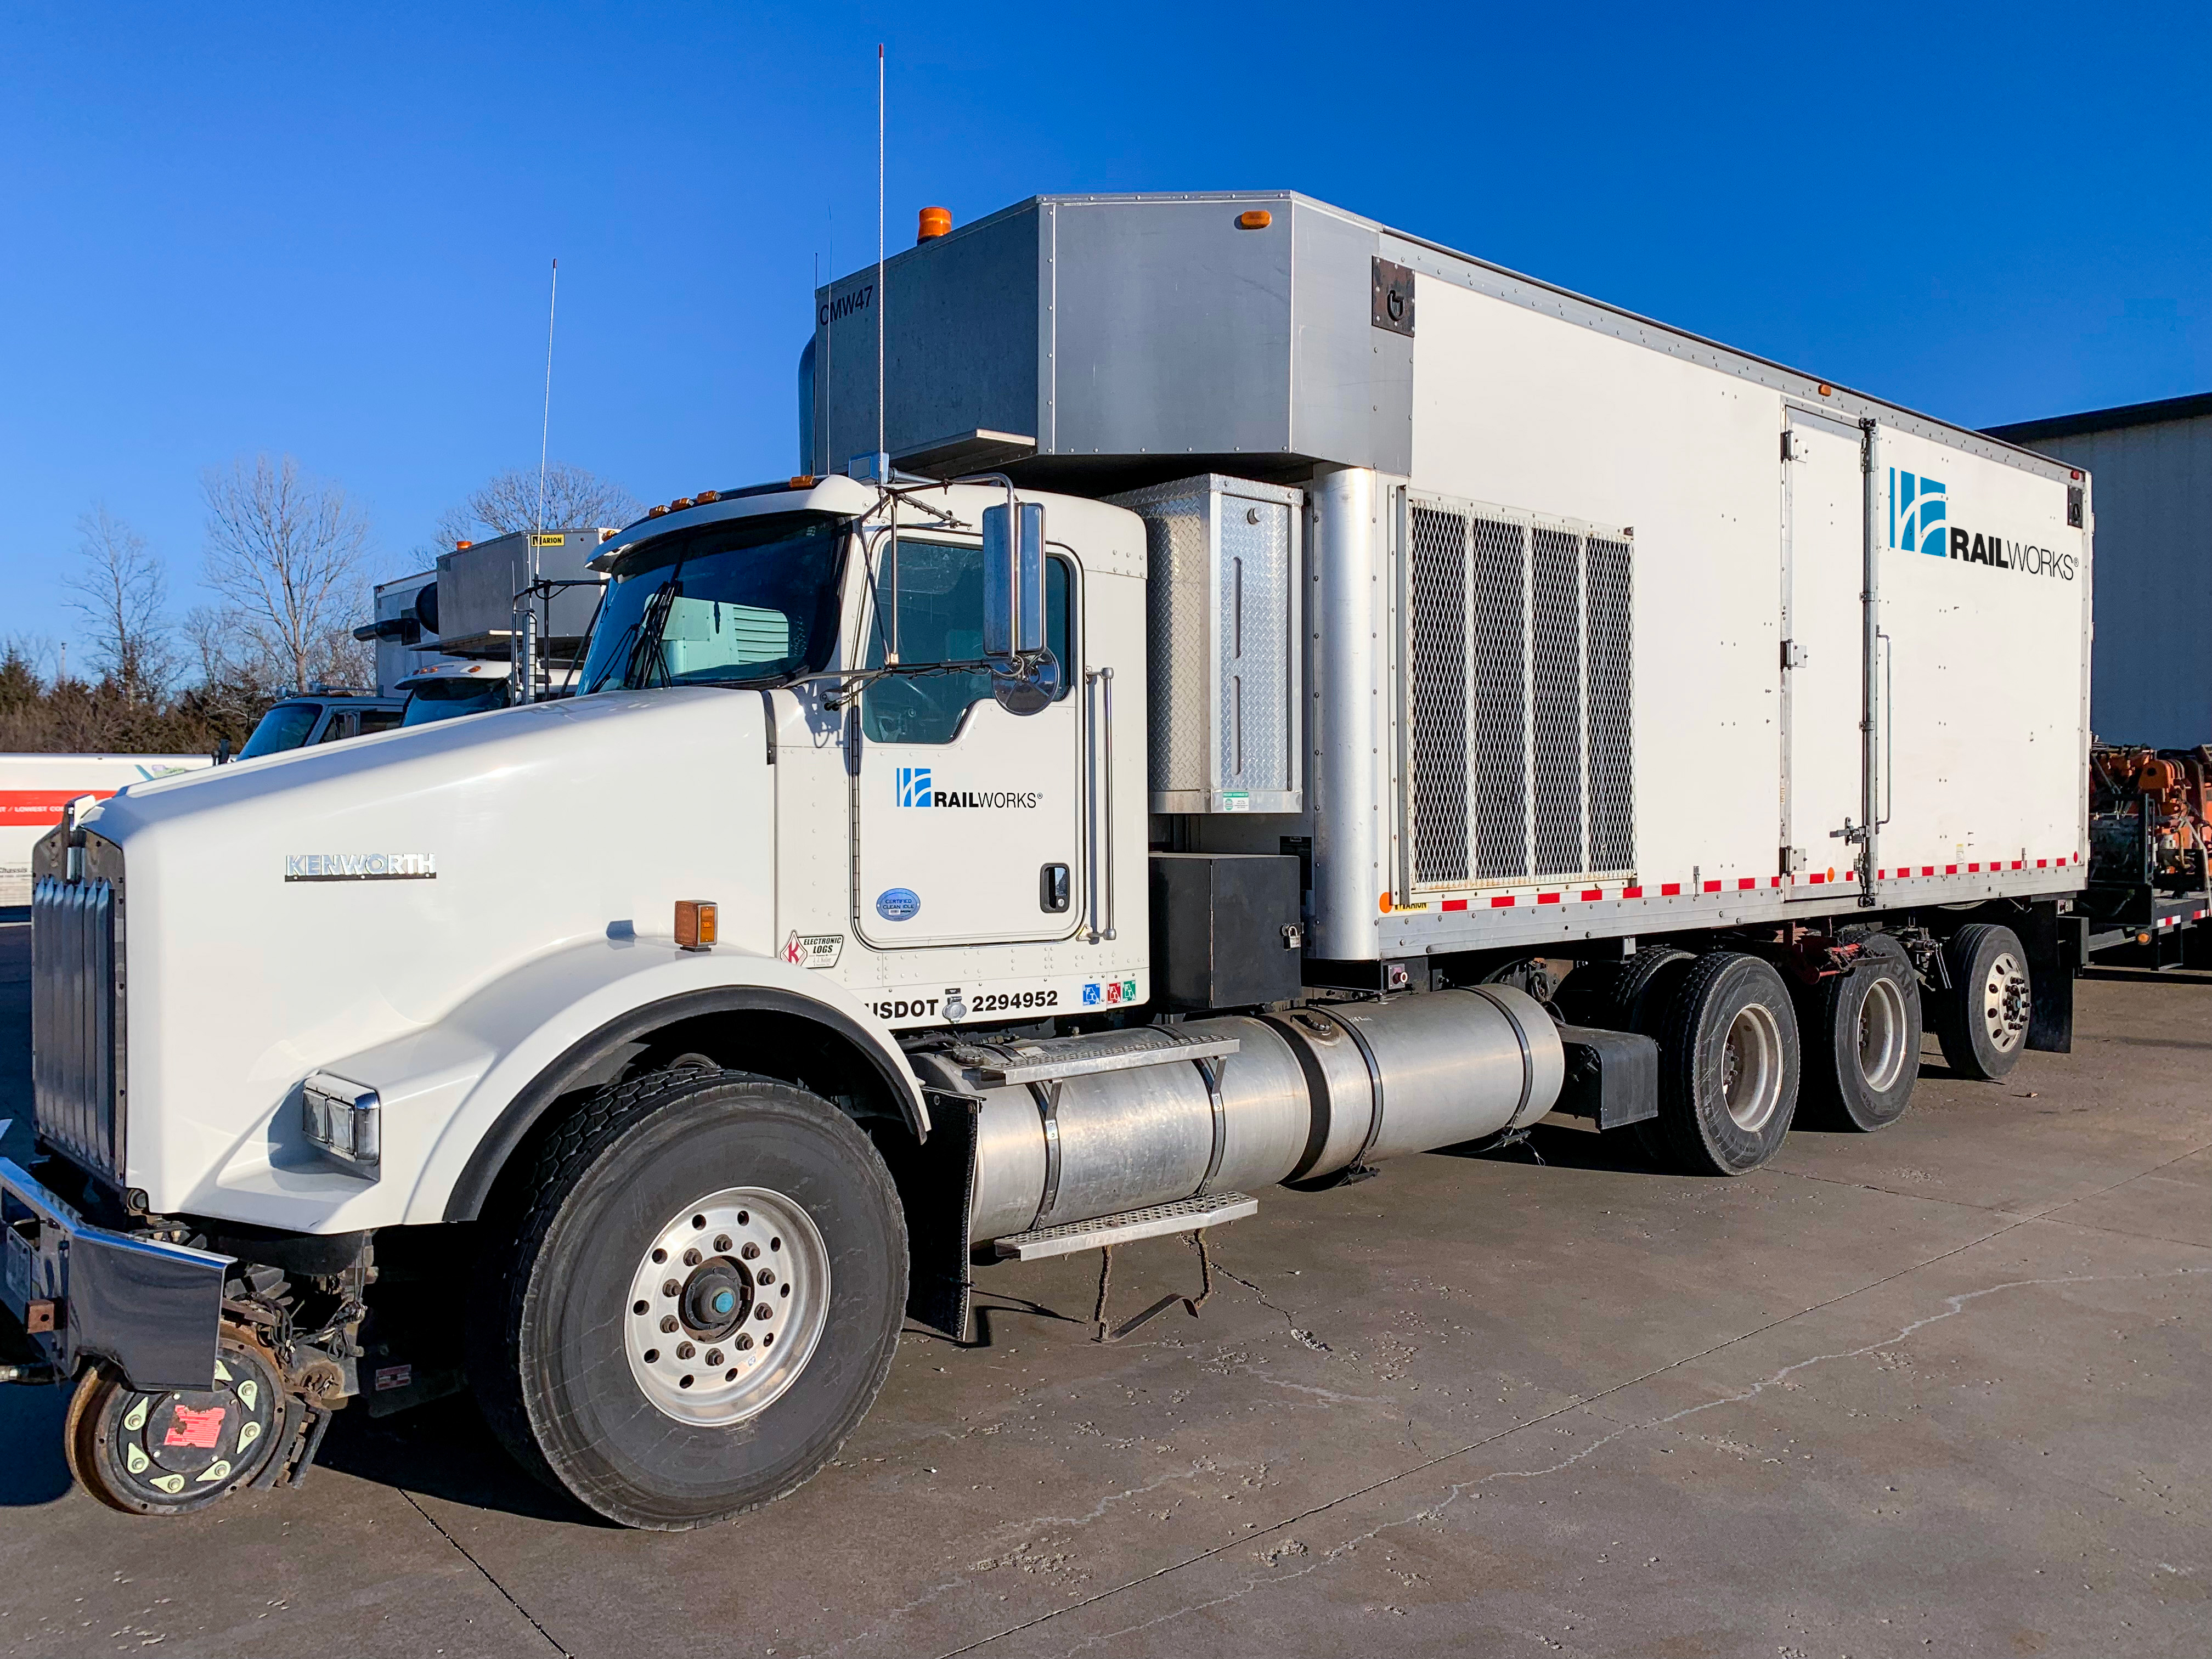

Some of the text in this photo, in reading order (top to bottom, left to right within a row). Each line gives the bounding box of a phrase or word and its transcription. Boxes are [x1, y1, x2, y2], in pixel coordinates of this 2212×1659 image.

[532, 535, 562, 546] MARION
[286, 853, 436, 877] KENWORTH
[803, 936, 842, 946] ELECTRONIC
[812, 945, 833, 954] LOGS
[972, 990, 1036, 1013] 2294952
